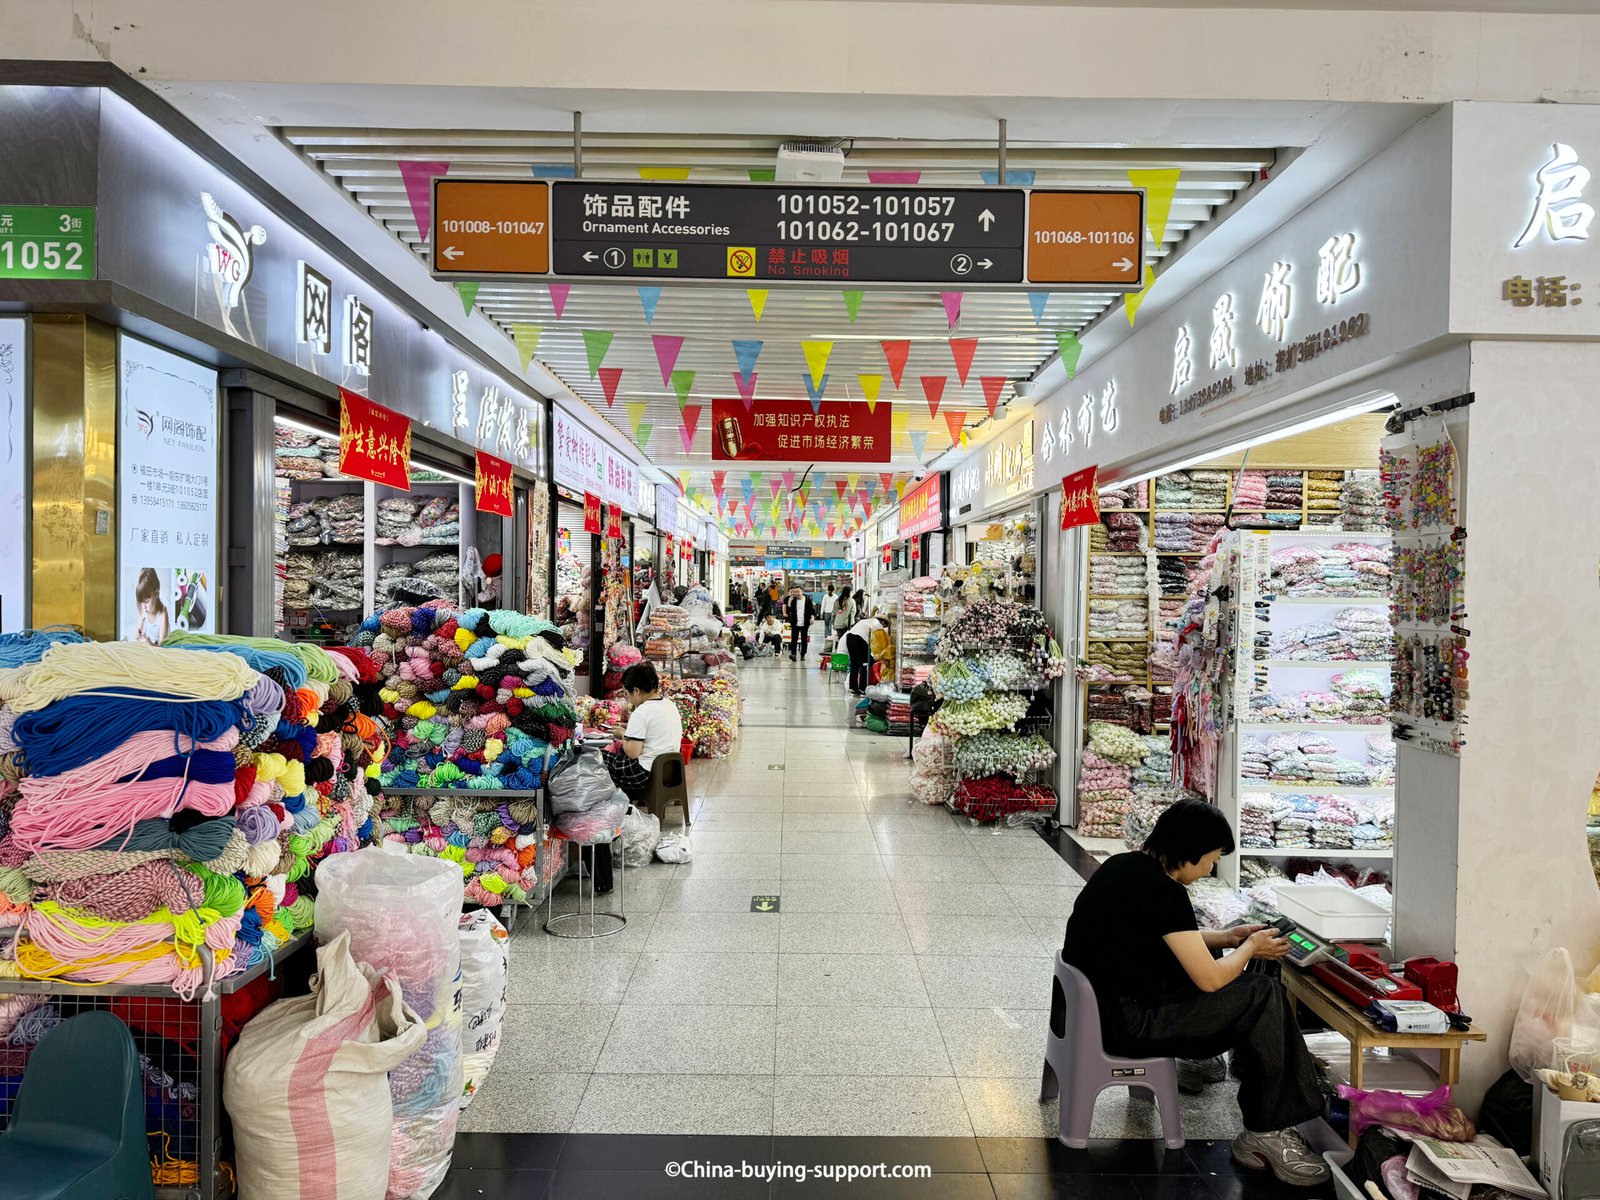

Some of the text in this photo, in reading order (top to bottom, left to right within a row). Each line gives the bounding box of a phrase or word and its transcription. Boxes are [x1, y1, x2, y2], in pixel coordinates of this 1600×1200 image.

[776, 195, 956, 216] 101052-101057
[1513, 143, 1596, 248] 启
[582, 194, 690, 219] 饰品配件
[59, 213, 82, 233] 3街
[442, 219, 544, 235] 101008-101047
[582, 221, 730, 237] Ornament Accessories
[776, 220, 955, 242] 101062-101067
[1033, 230, 1135, 245] 101068-101106
[1, 240, 83, 270] 1052
[768, 248, 850, 266] 禁止吸烟
[768, 265, 850, 278] No Smoking
[296, 259, 374, 375] 网阁
[161, 415, 207, 442] 网阁饰配
[753, 412, 850, 429] 加强知识产权执法
[354, 422, 401, 466] 生意兴隆
[777, 434, 875, 450] 促进市场经济繁荣
[131, 527, 209, 547] 厂家直销 私人定制
